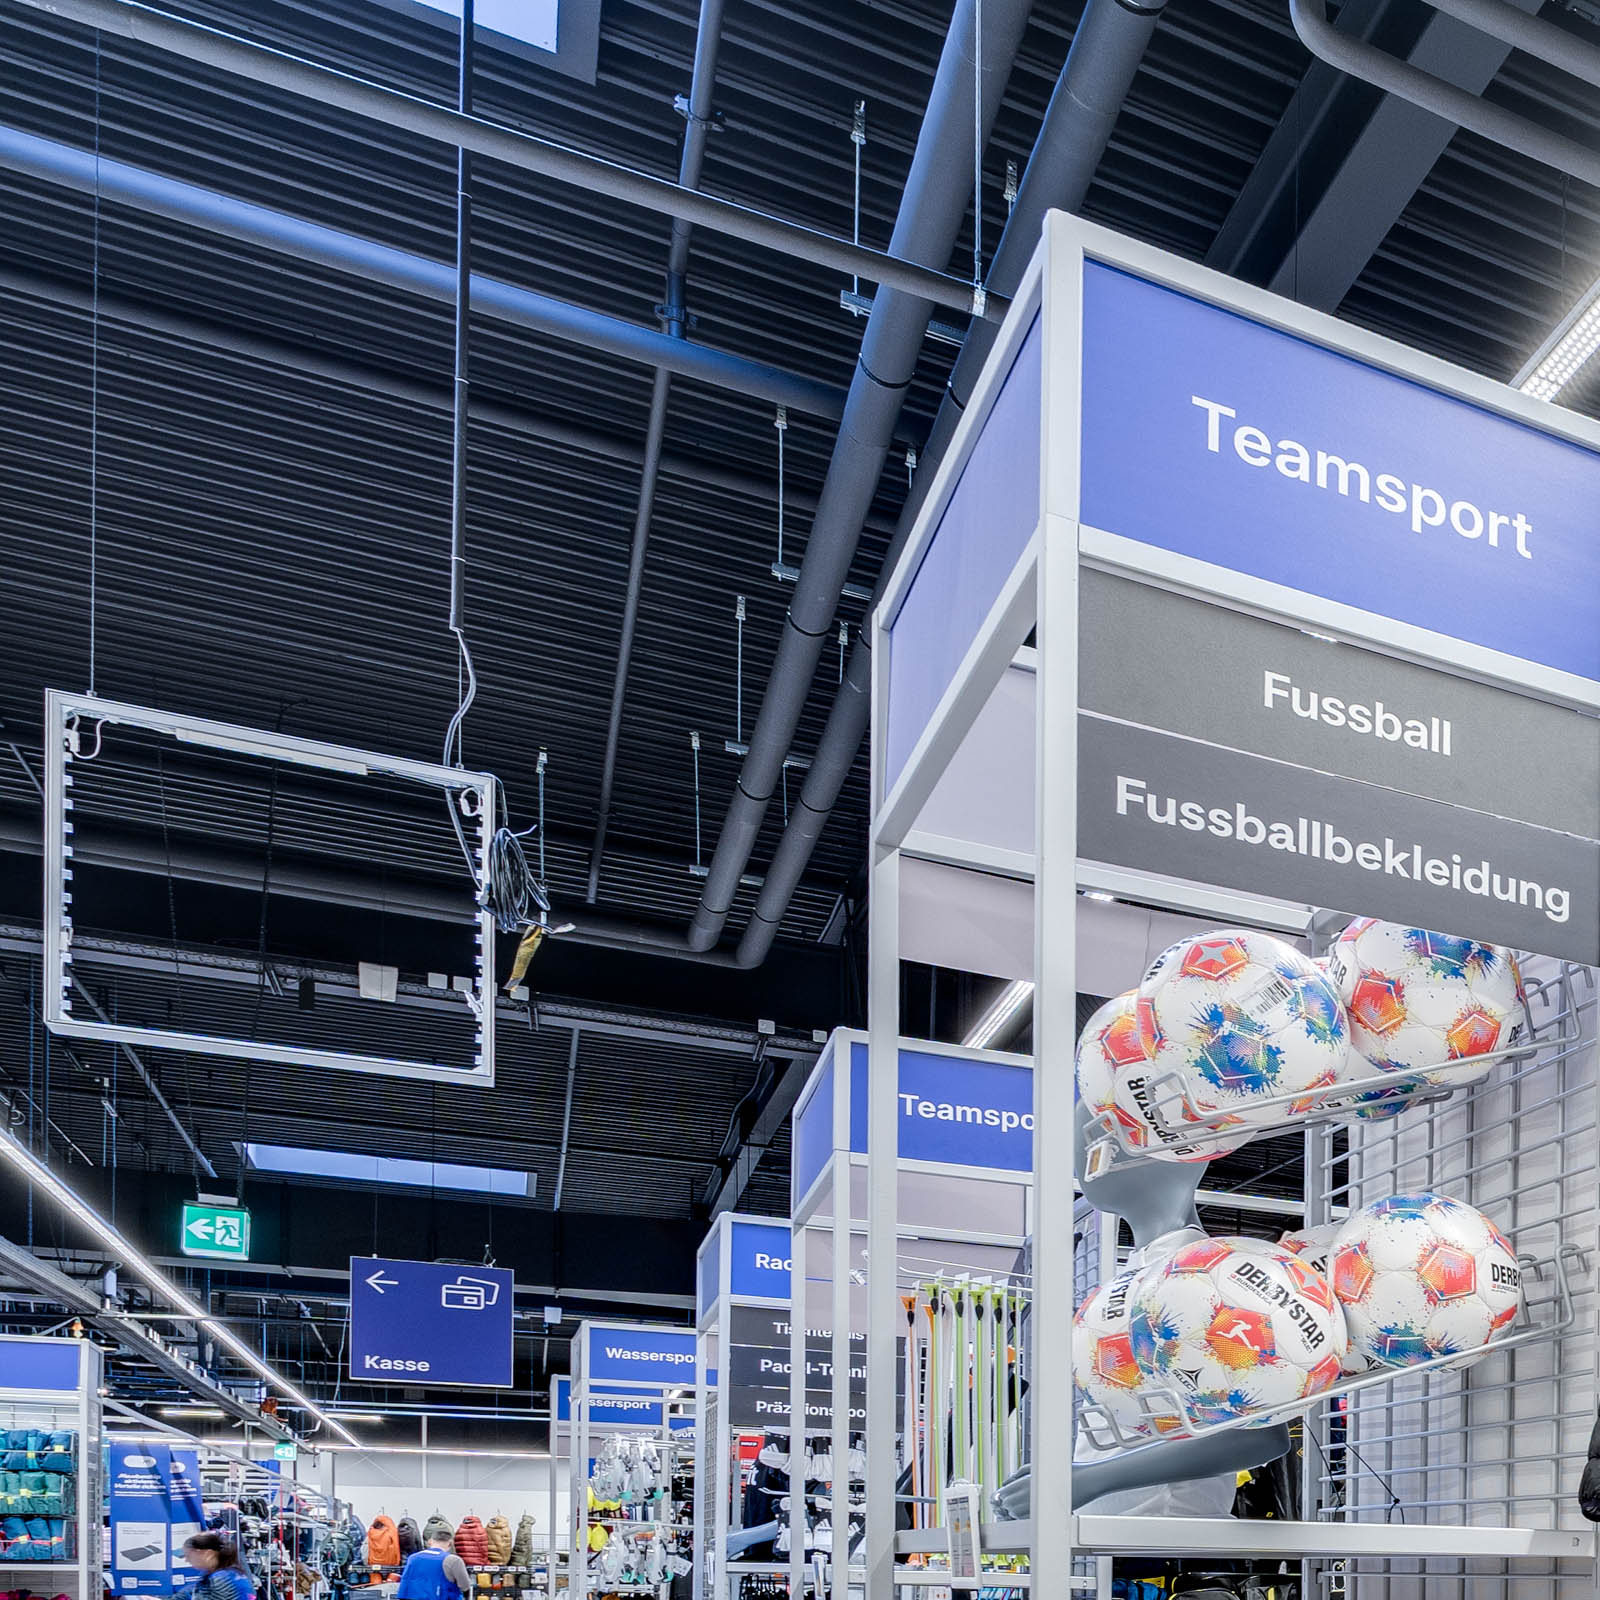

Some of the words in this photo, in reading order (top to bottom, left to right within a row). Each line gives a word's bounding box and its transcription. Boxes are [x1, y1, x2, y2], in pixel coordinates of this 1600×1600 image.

[1191, 395, 1533, 559] Teamsport
[1263, 670, 1452, 758] Fussball
[1115, 774, 1571, 924] Fussballbekleidung
[898, 1093, 1034, 1133] Teamspo
[1127, 1077, 1195, 1156] DRBYSTAR
[1235, 1261, 1325, 1350] DERBYSTAR
[1237, 1278, 1273, 1305] BUNDESLIGA
[364, 1354, 431, 1372] Kasse
[1173, 1368, 1197, 1393] SELECT
